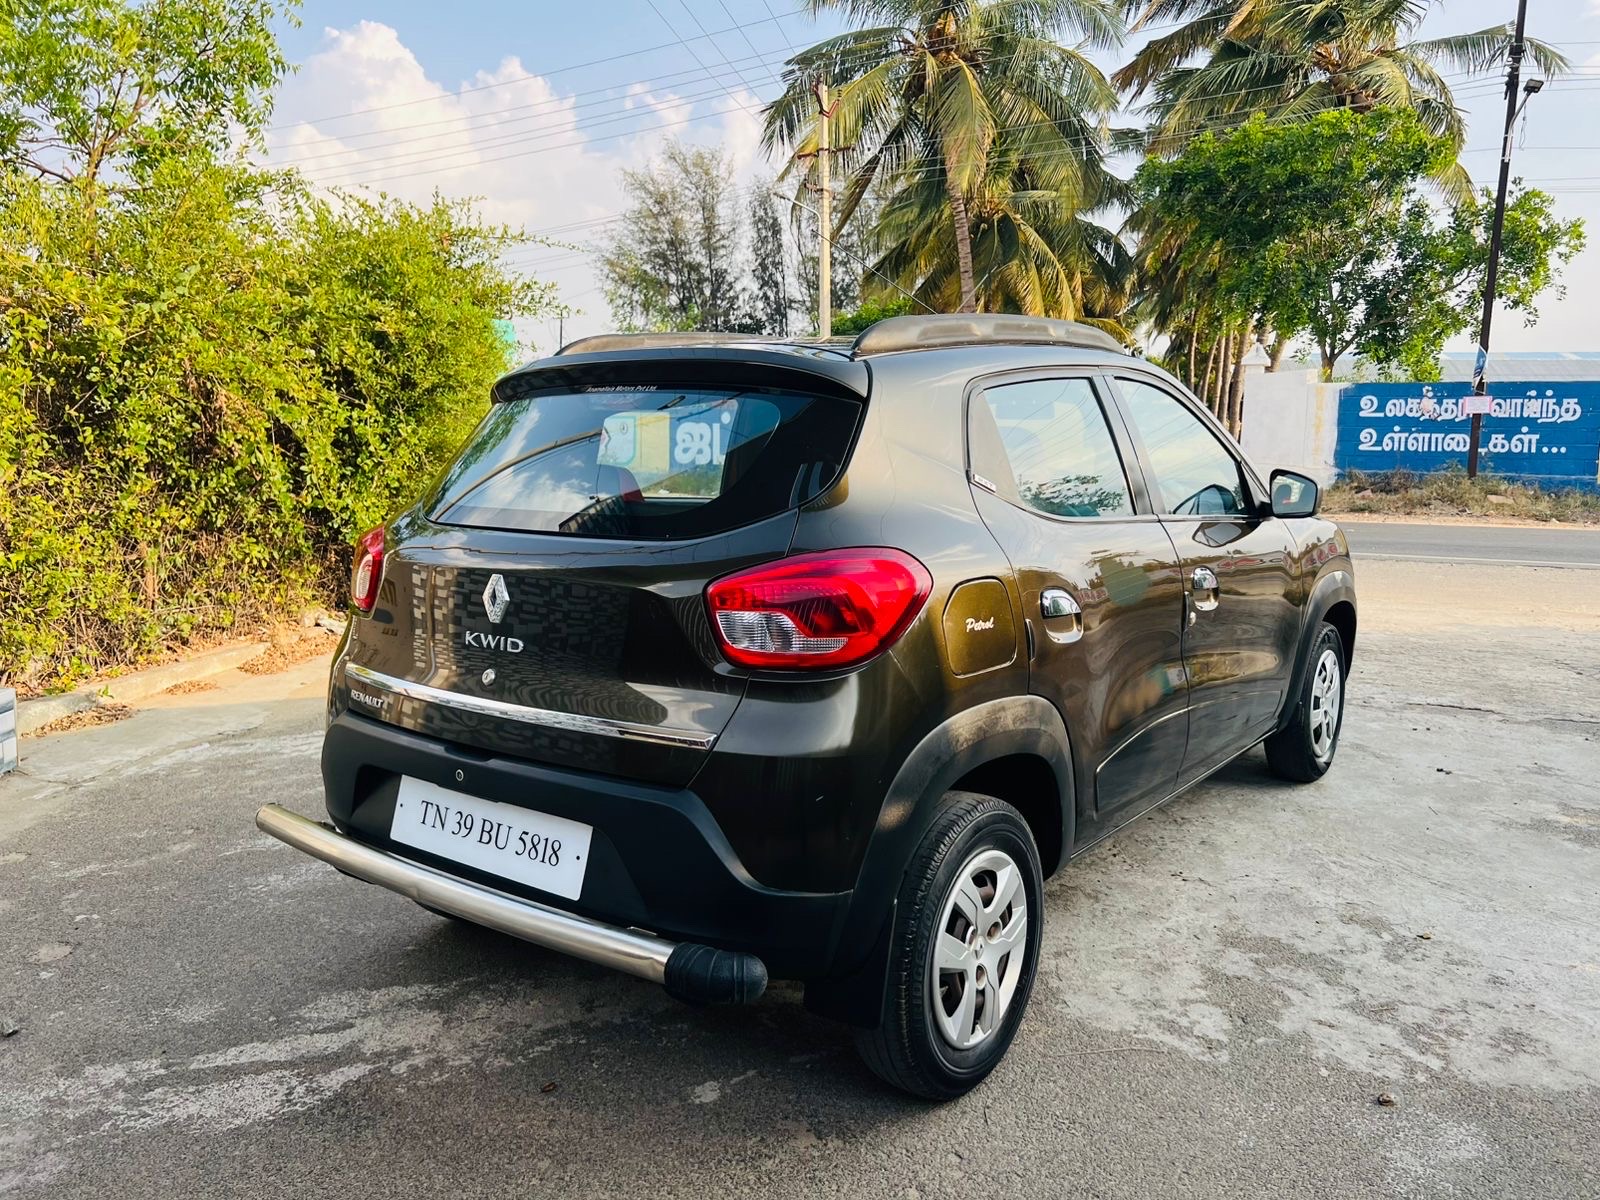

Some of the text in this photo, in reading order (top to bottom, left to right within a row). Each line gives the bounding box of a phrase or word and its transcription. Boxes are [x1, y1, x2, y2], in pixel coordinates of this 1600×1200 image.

[965, 616, 995, 633] Petrol
[464, 630, 524, 654] KWID
[350, 689, 386, 709] RENAULT
[420, 800, 562, 867] TN 39 BU 5818
